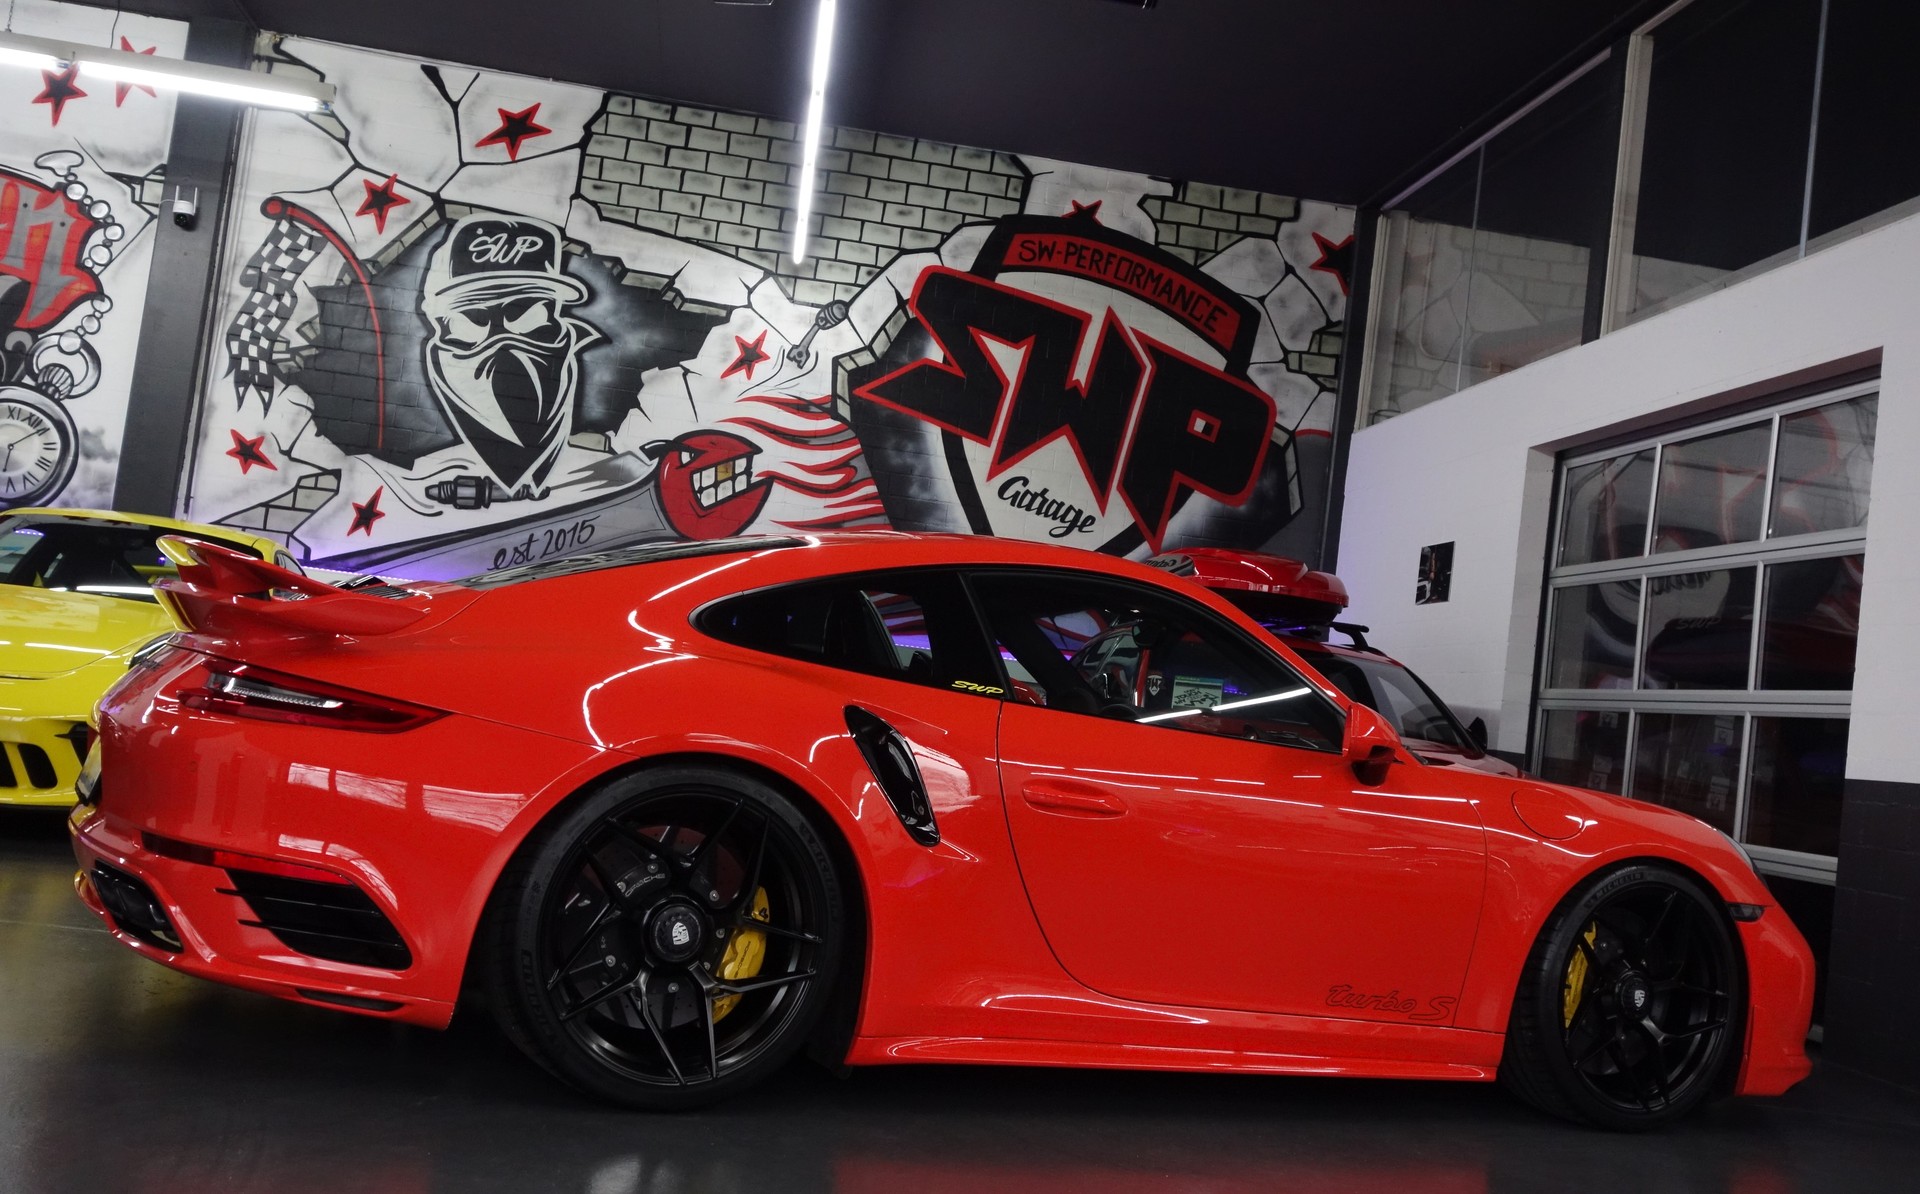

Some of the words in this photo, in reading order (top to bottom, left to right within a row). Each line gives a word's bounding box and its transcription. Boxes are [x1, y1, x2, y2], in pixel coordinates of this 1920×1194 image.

[468, 232, 544, 265] SWP
[1017, 238, 1233, 334] SW-PERFORMANCE
[852, 265, 1278, 555] SWP
[997, 475, 1097, 538] Garage
[486, 532, 540, 571] est
[540, 515, 601, 559] 2015
[951, 680, 1004, 694] SWP
[1325, 984, 1417, 1013] turbo
[1408, 996, 1457, 1021] S
